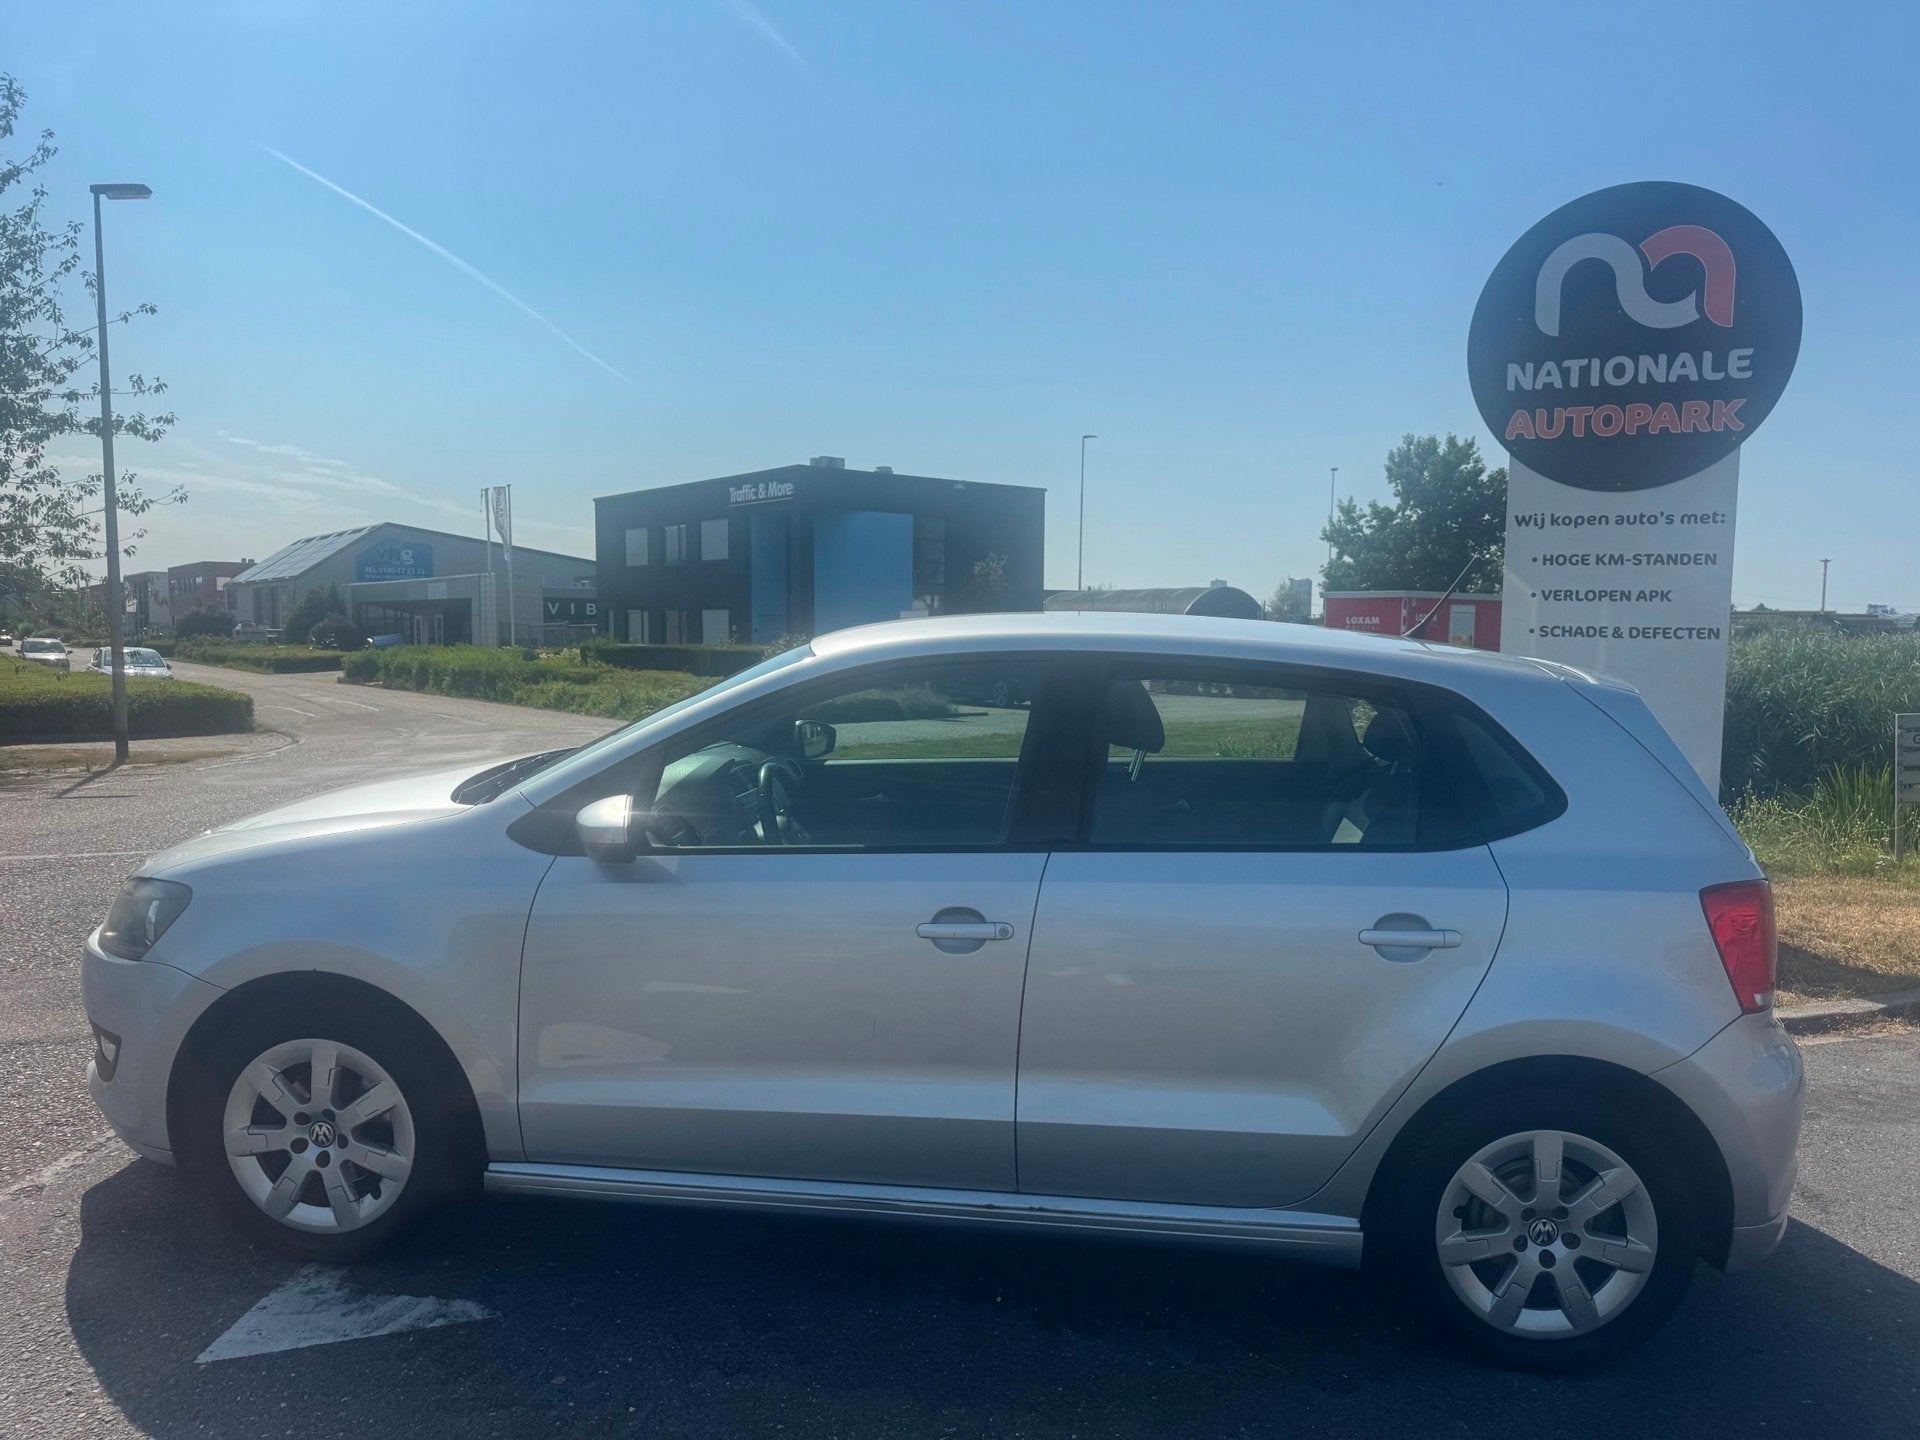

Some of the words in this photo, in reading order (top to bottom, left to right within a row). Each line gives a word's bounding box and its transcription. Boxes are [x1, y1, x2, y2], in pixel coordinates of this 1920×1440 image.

[1506, 348, 1754, 392] NATIONALE
[1505, 398, 1748, 440] AUTOPARK
[729, 484, 756, 502] Traffic
[757, 482, 767, 499] &
[767, 481, 794, 498] More
[1514, 513, 1546, 530] Wij
[1550, 513, 1609, 529] kopen
[1614, 510, 1675, 526] auto's
[1680, 511, 1726, 525] met:
[1542, 553, 1591, 567] HOGE
[1595, 552, 1718, 566] KM-STANDEN
[1540, 589, 1632, 602] VERLOPEN
[1635, 589, 1673, 603] APK
[1345, 616, 1379, 624] LOXAM
[1538, 625, 1609, 639] SCHADE
[1611, 626, 1625, 640] &
[1627, 627, 1721, 640] DEFECTEN
